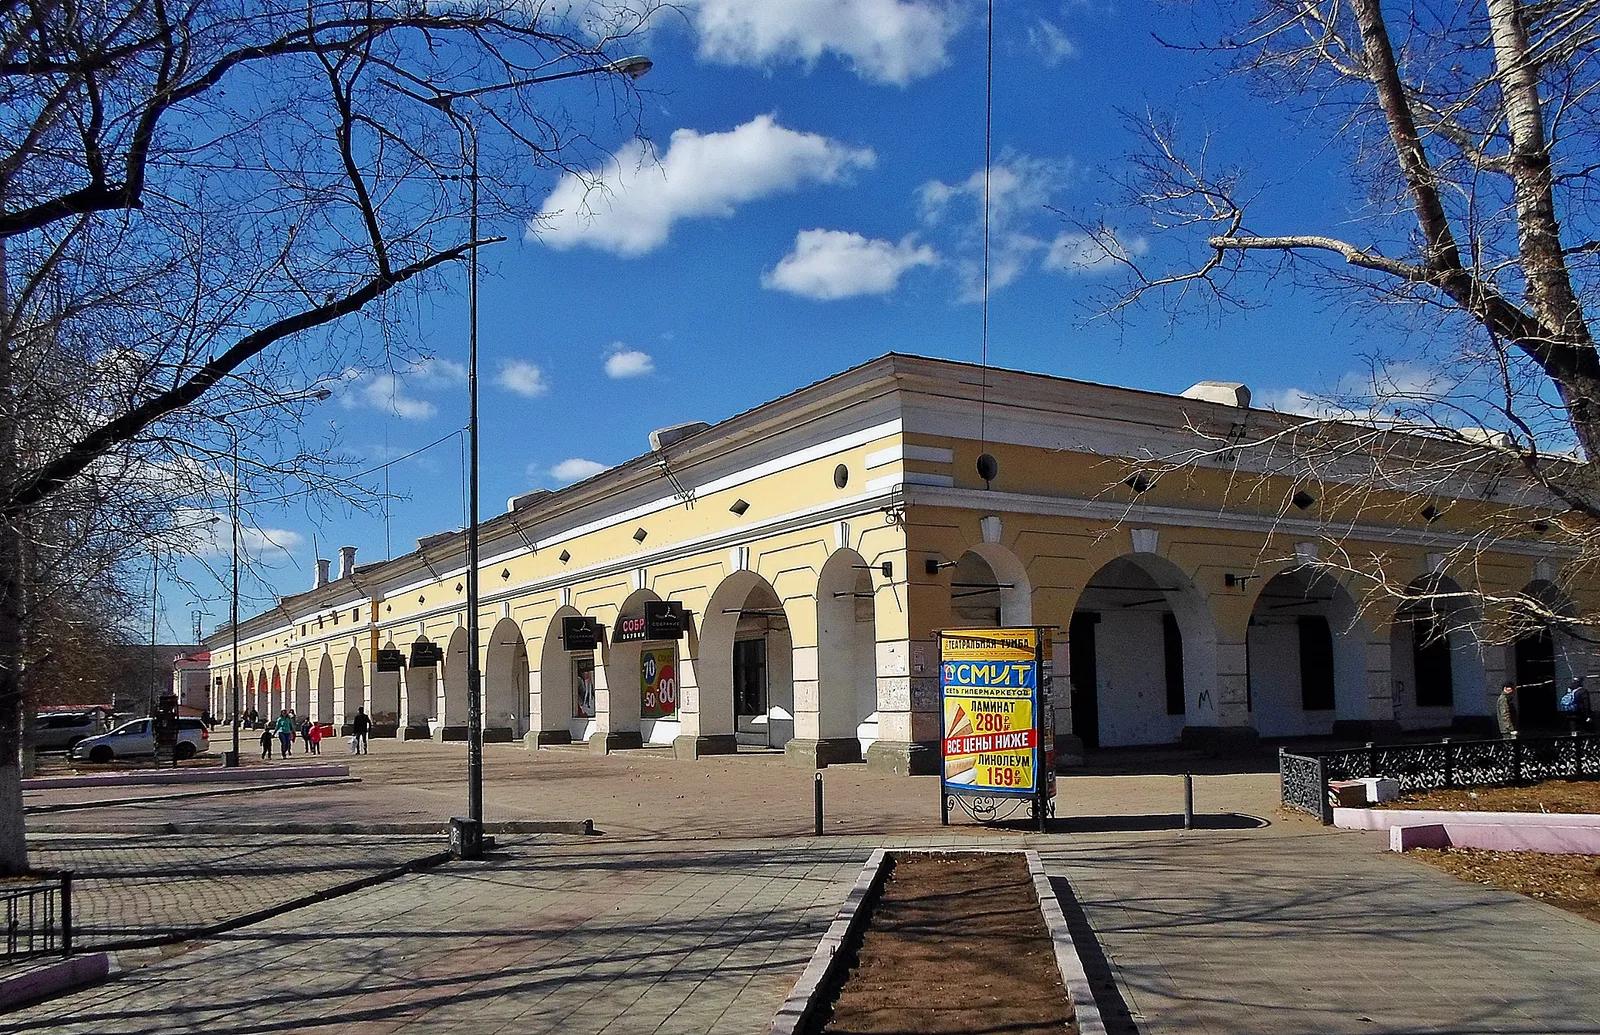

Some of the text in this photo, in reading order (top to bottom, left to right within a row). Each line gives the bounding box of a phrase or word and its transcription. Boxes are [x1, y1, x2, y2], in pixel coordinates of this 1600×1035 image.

[948, 638, 997, 650] ТЕАТРАЛЬНАЯ
[1000, 638, 1029, 649] ТУМБА
[957, 664, 1031, 686] СМИТ
[945, 687, 1030, 697] СЕТЬ ГИПЕРМАРКЕТОВ
[970, 700, 1016, 713] ЛАМИНАТ
[975, 712, 1003, 732] 280
[947, 732, 1029, 754] ВСЕ ЦЕНЫ НИЖЕ
[977, 753, 1030, 767] ЛИНОЛЕУМ
[986, 766, 1014, 786] 159
